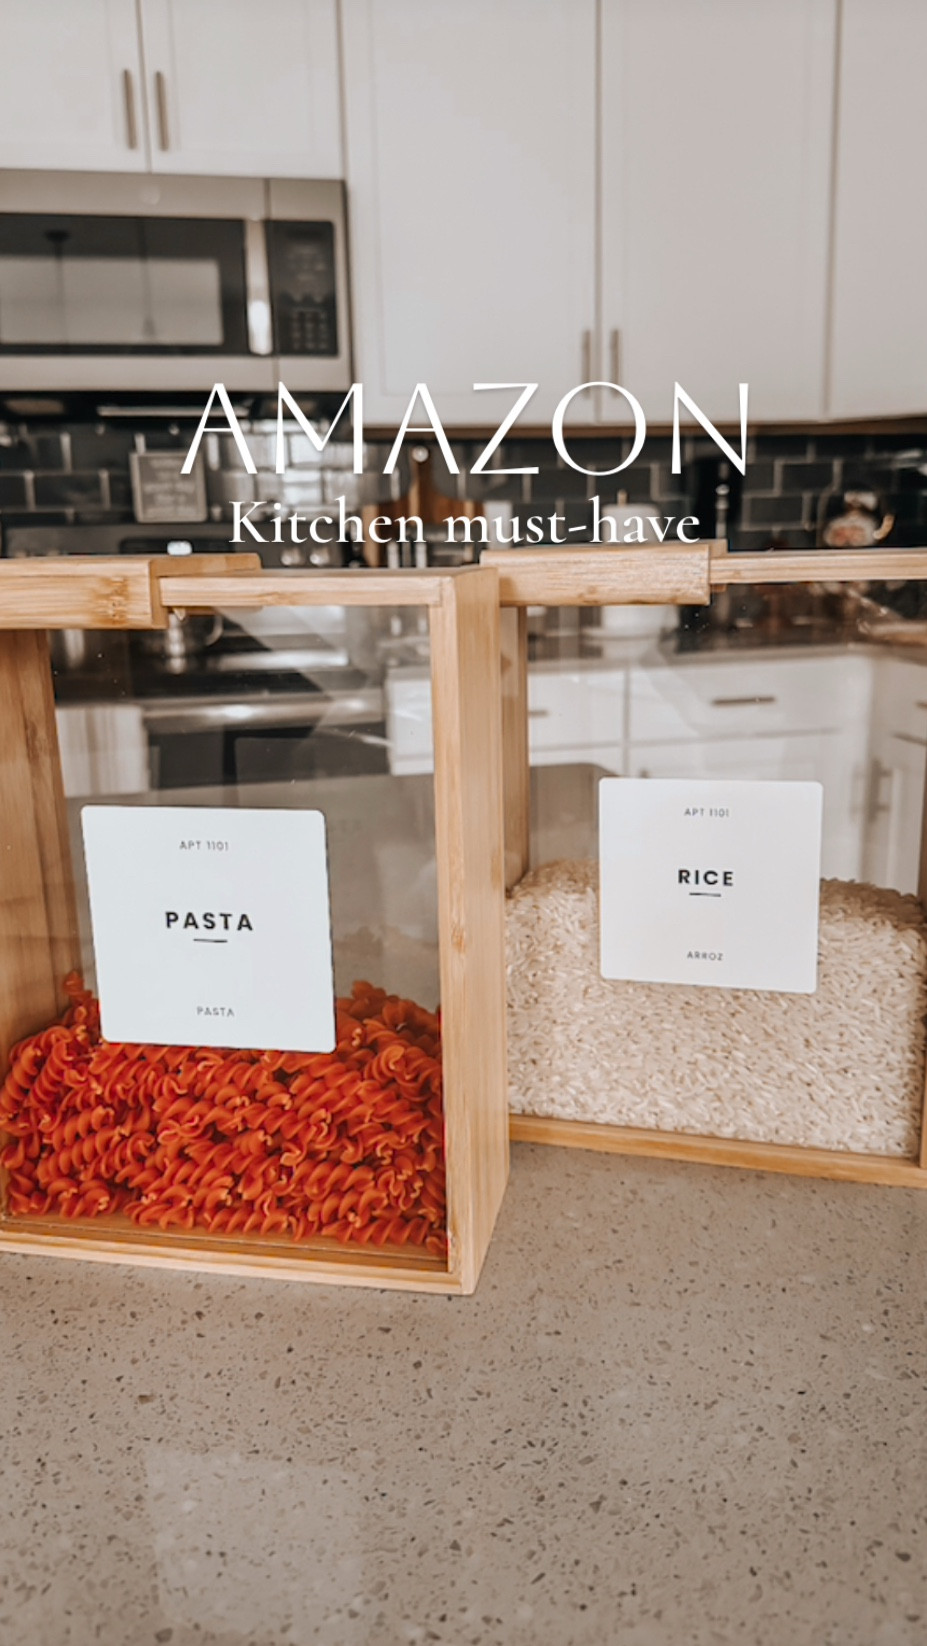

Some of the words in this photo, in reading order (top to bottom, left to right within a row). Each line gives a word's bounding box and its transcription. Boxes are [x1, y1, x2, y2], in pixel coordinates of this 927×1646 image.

[683, 807, 705, 818] APT
[709, 808, 730, 818] 1101
[179, 840, 201, 851] APT
[206, 840, 229, 852] 1101
[677, 869, 734, 887] RICE
[165, 911, 253, 931] PASTA
[686, 950, 724, 962] ARROZ
[196, 1006, 235, 1018] PASTA
